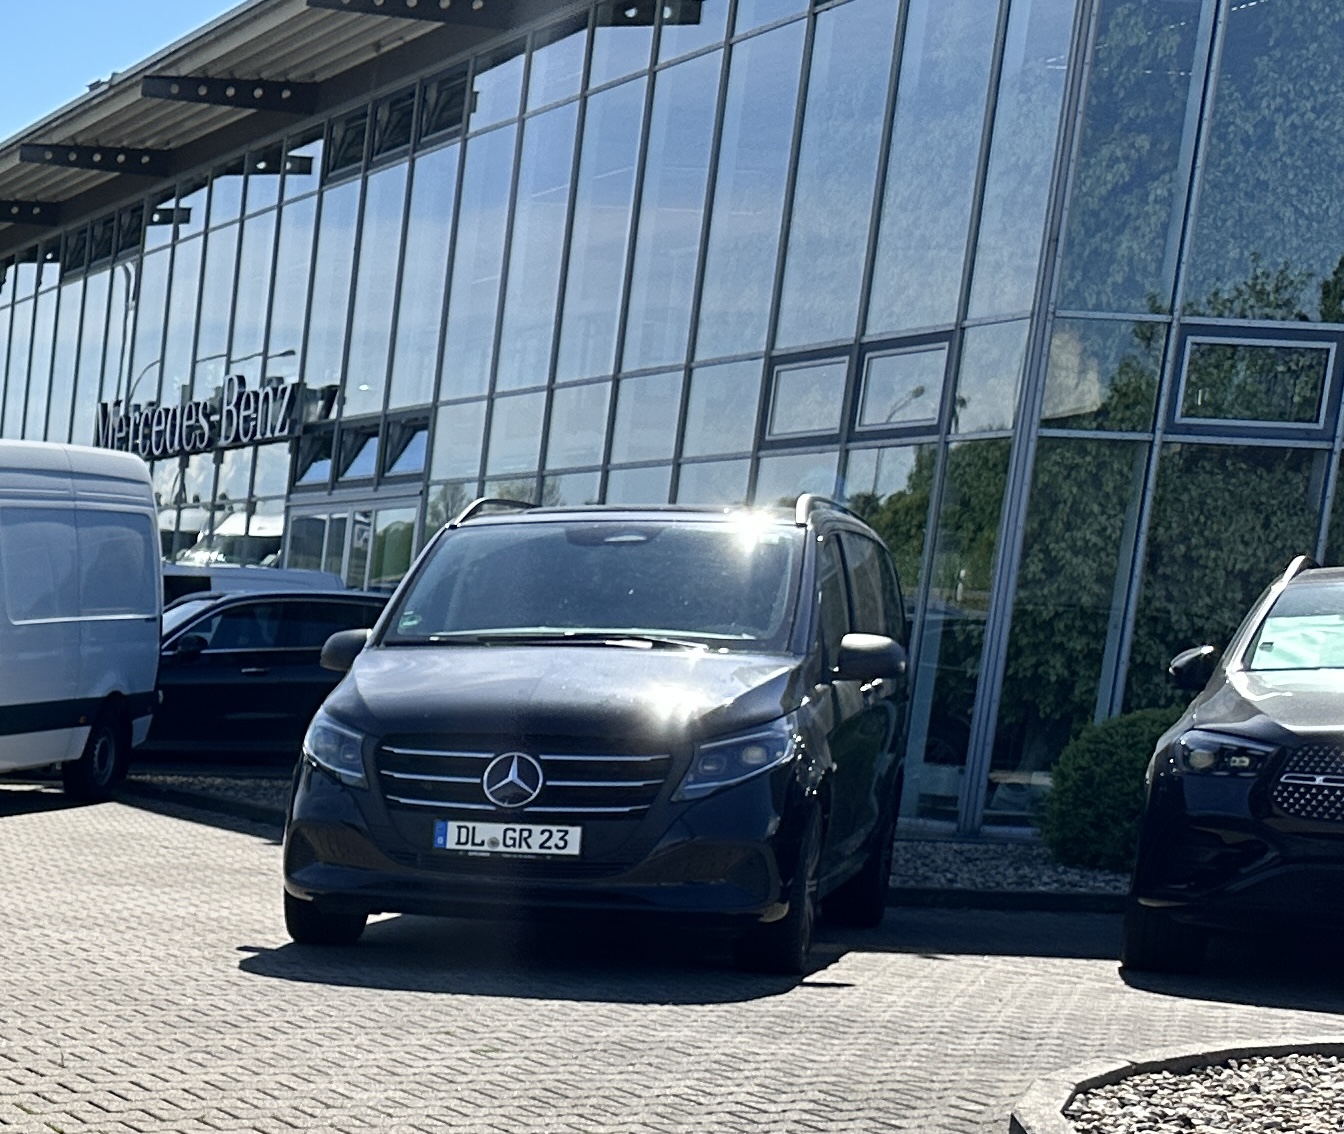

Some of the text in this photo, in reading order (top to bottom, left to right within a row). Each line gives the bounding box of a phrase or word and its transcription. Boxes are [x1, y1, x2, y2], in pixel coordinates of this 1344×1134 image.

[96, 374, 293, 456] Mercedes-Benz
[455, 825, 569, 850] DL GR 23
